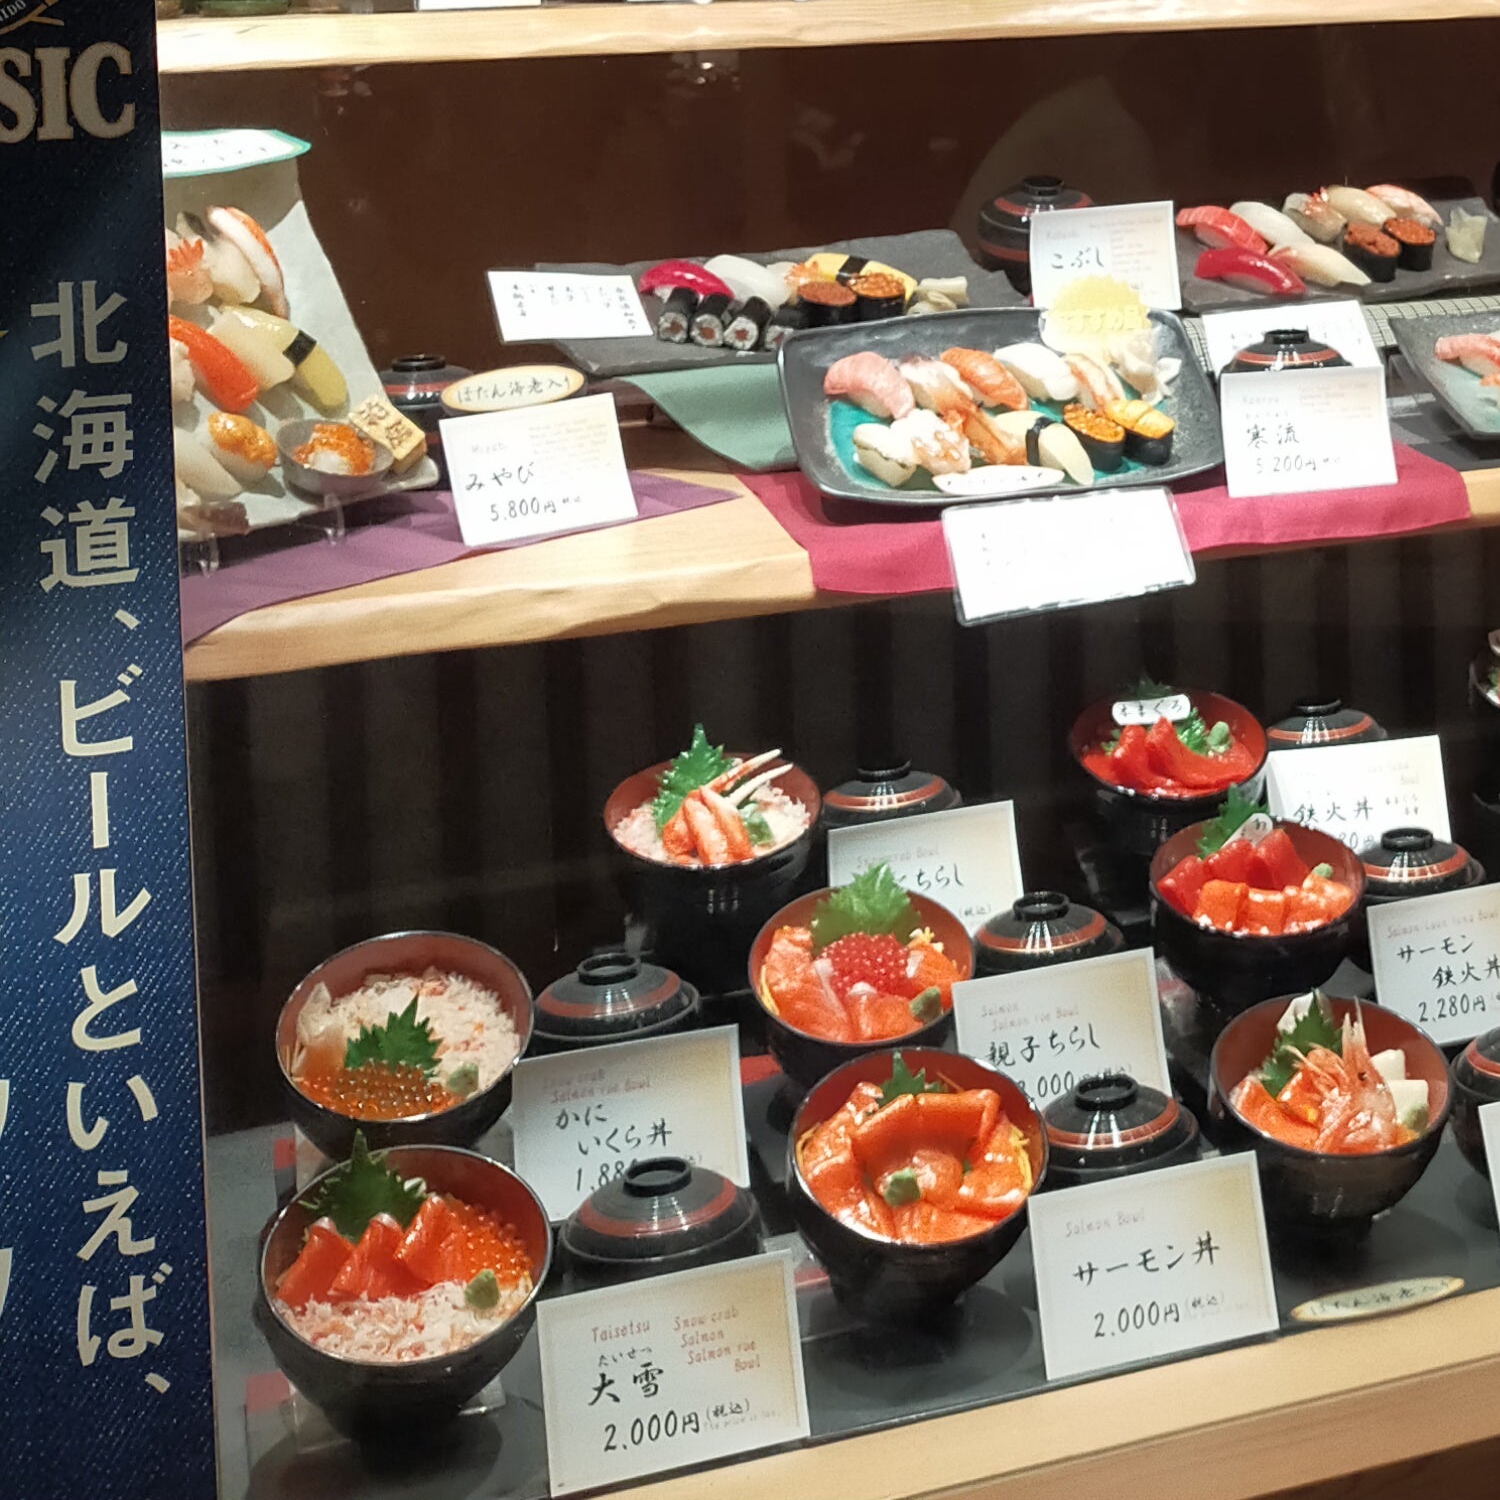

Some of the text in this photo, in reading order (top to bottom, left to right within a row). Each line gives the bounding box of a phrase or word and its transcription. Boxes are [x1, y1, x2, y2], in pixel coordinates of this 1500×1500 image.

[1051, 246, 1105, 270] こぶし
[1246, 422, 1301, 449] 寒流
[464, 461, 536, 492] みやび
[1293, 795, 1374, 824] 鉄火丼
[30, 279, 171, 1394] 北海道、ビールといえば、
[1396, 934, 1474, 965] サーモン
[985, 1022, 1101, 1068] 親子ちらし
[555, 1103, 608, 1130] かに
[577, 1117, 673, 1156] いくら丼
[1072, 1229, 1221, 1287] サーモン丼
[591, 1319, 651, 1345] Taisetsu
[680, 1329, 726, 1349] Salmon
[597, 1346, 654, 1368] たいせつ
[687, 1346, 733, 1366] Salmon
[734, 1354, 761, 1373] Bowl
[587, 1361, 665, 1408] 大雪
